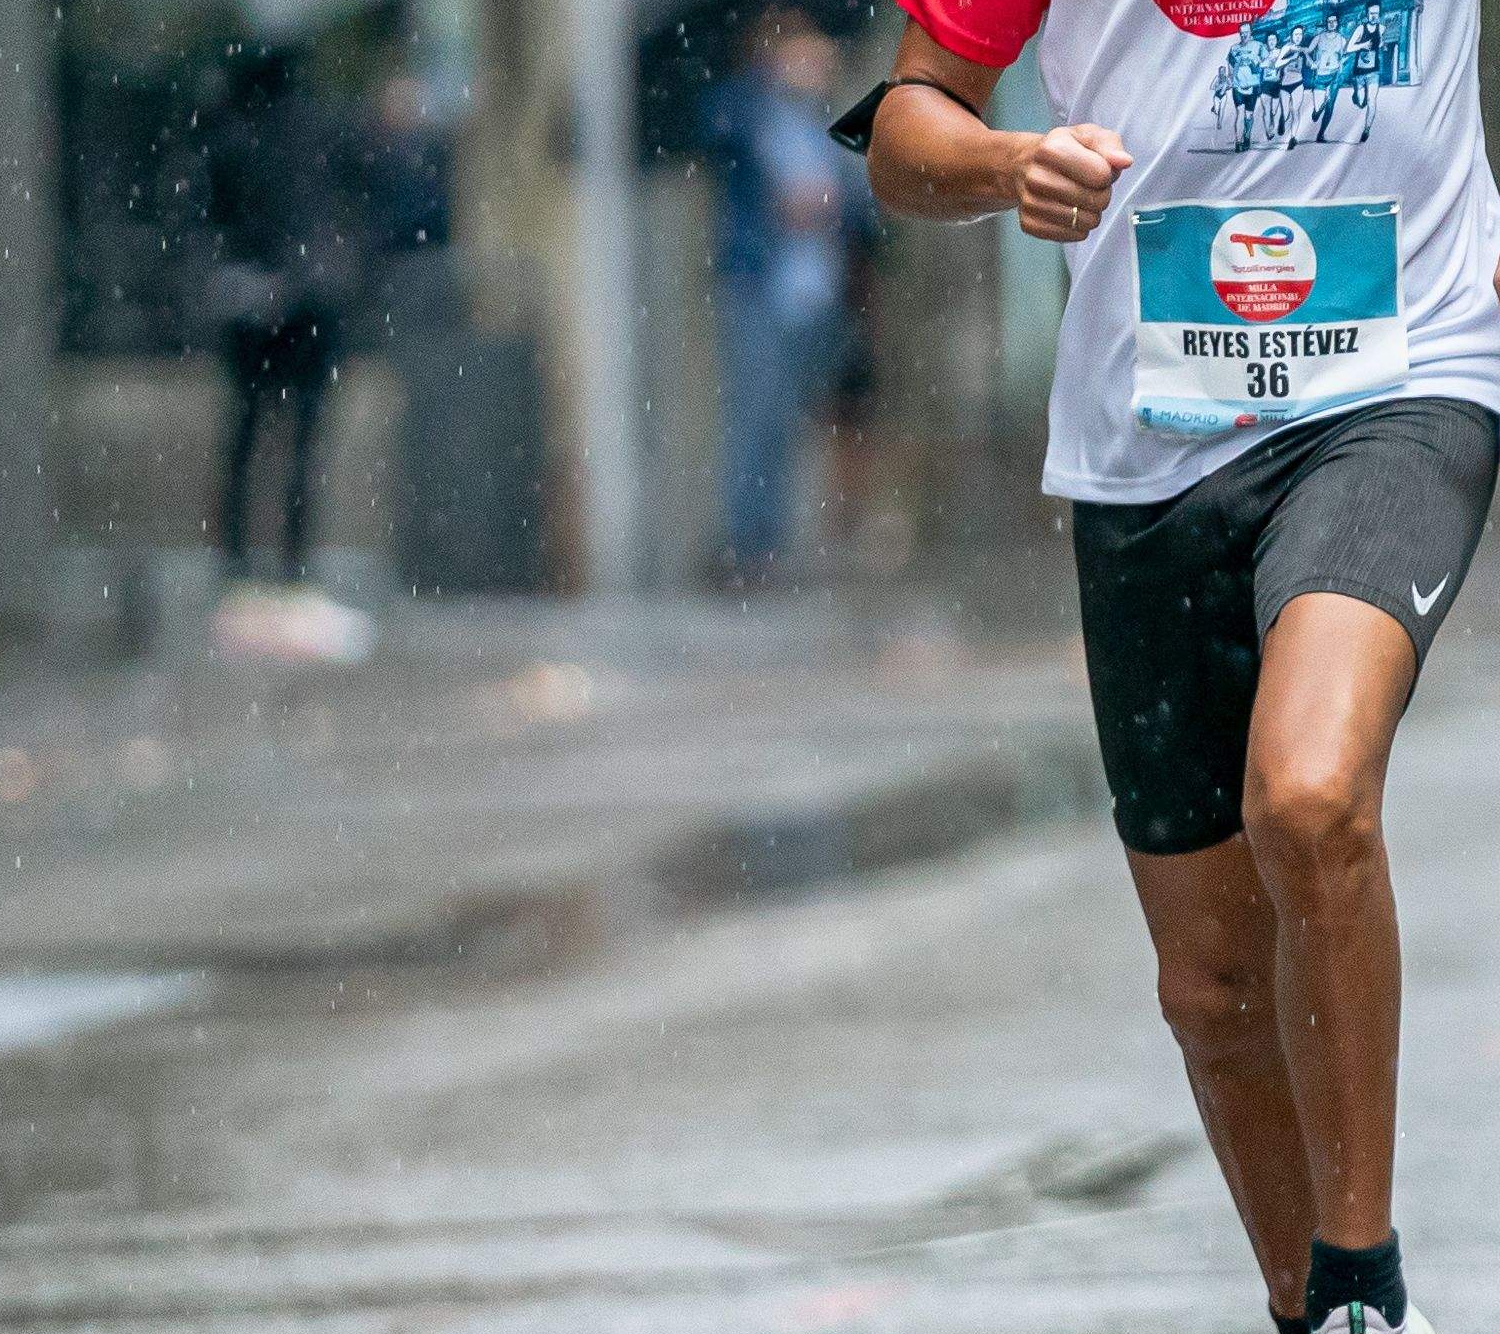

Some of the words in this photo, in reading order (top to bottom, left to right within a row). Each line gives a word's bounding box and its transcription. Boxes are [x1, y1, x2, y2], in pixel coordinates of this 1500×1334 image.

[1183, 16, 1201, 26] DE
[1203, 13, 1252, 26] MADRID
[1247, 283, 1278, 293] MILLA
[1182, 329, 1250, 359] REYES
[1259, 325, 1359, 359] ESTÉVEZ
[1246, 361, 1290, 399] 36
[1159, 409, 1219, 426] MADRID
